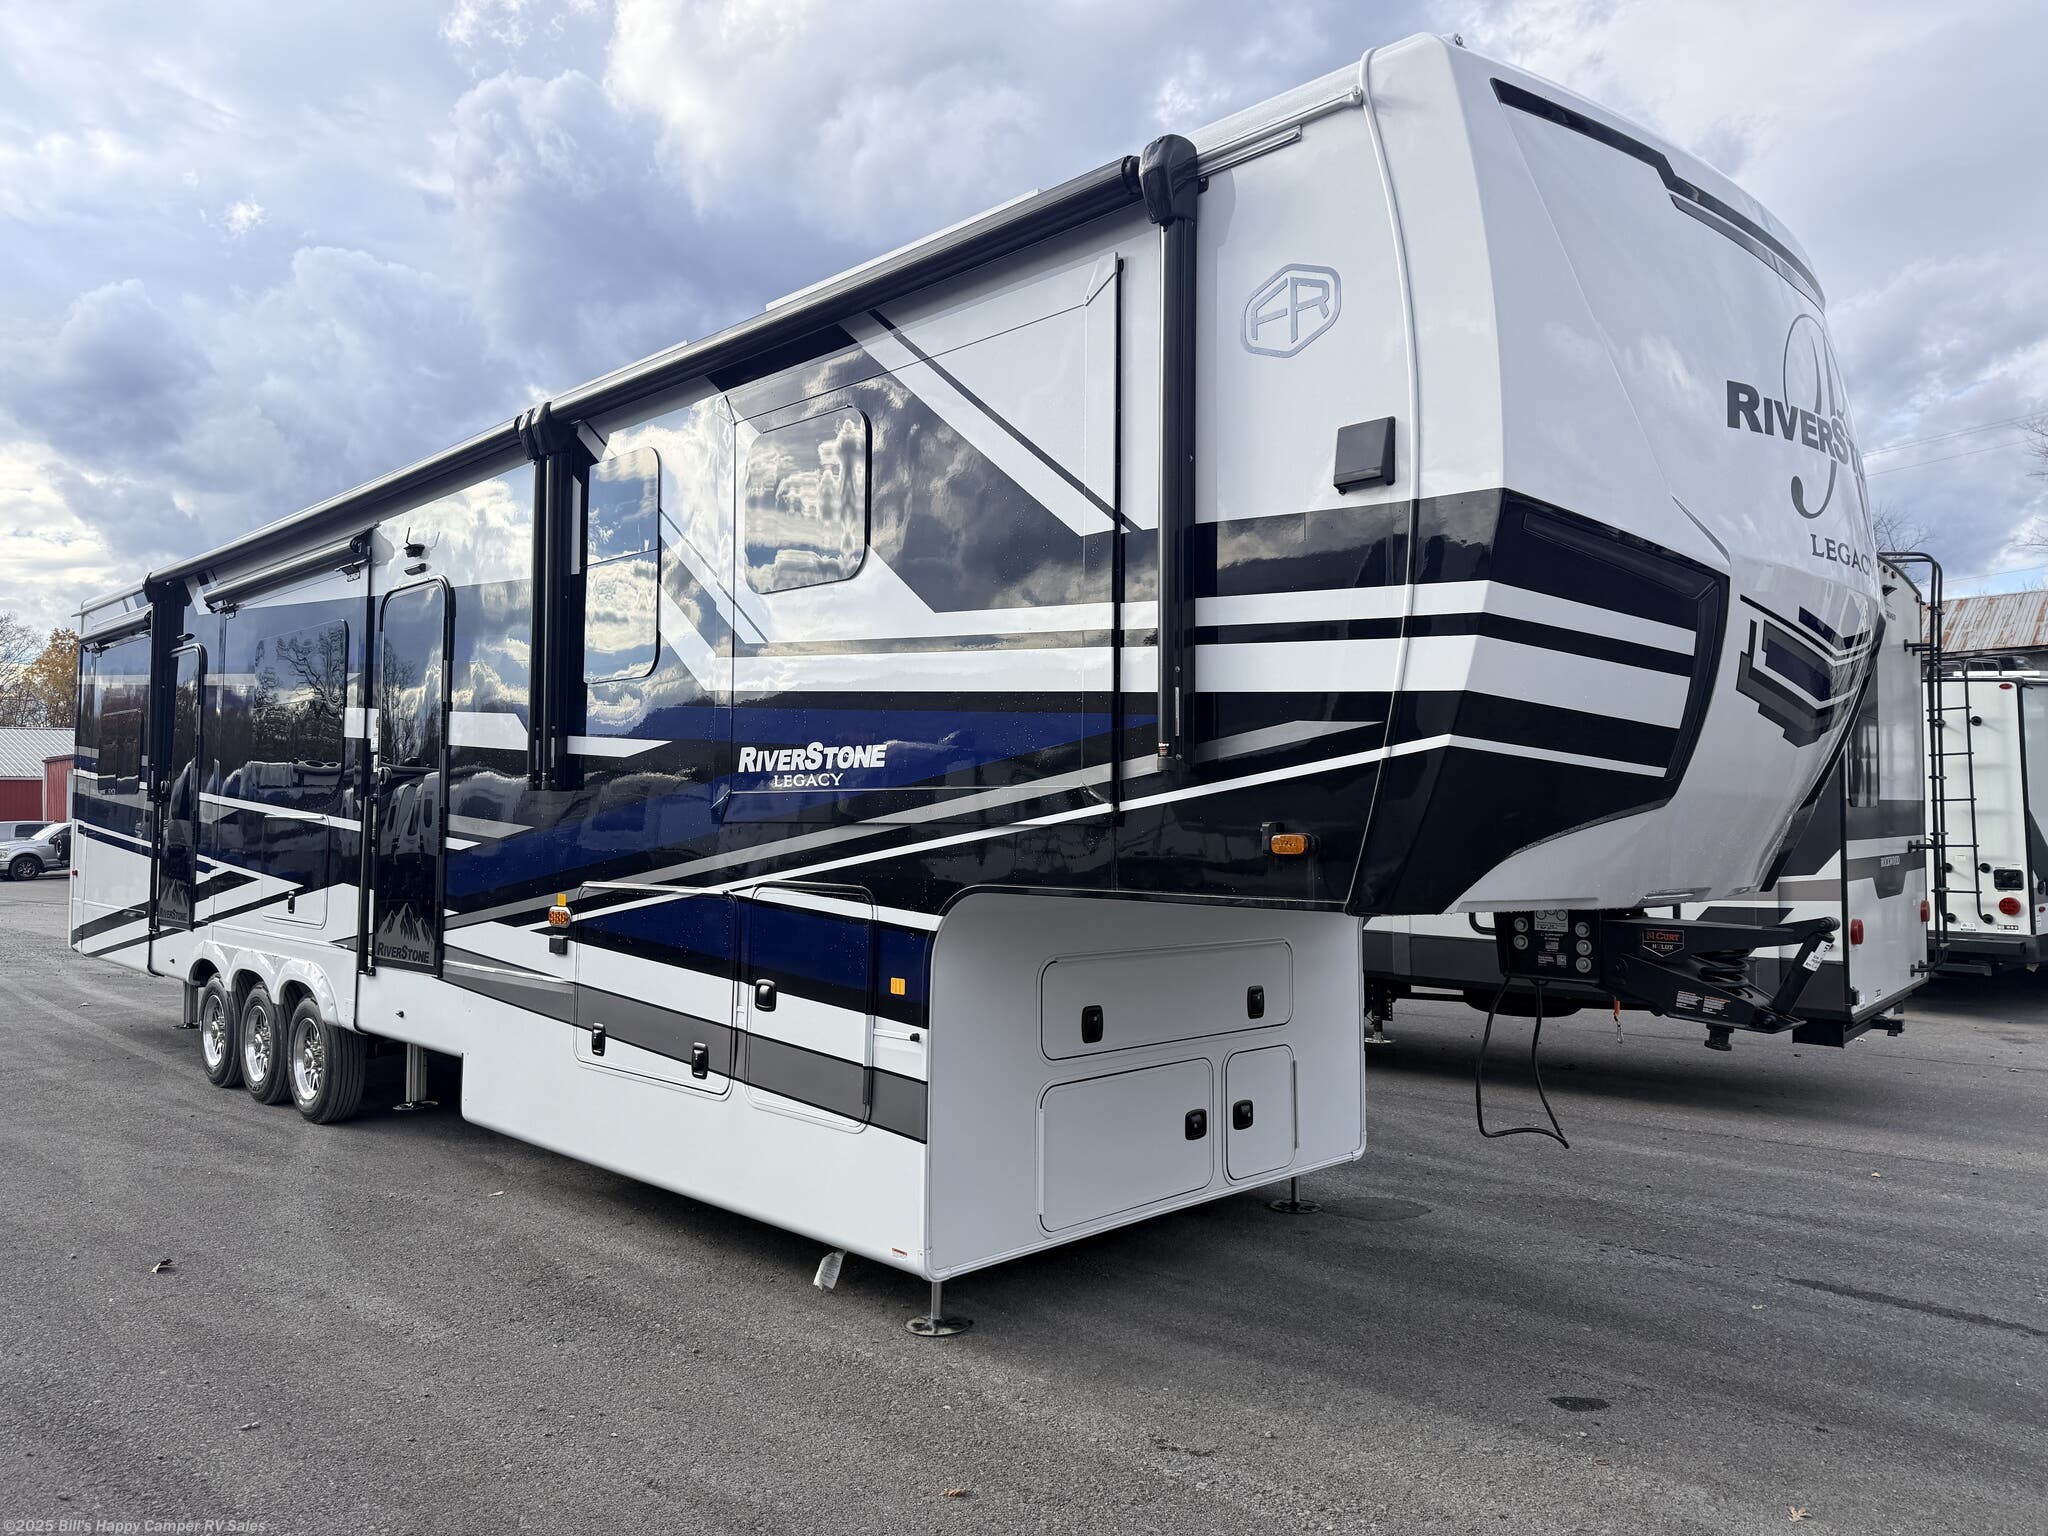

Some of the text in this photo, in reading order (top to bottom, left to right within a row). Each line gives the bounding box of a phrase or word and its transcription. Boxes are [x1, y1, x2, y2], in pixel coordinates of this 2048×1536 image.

[738, 741, 888, 773] RIVERSTONE
[774, 772, 844, 788] LEGACY
[377, 941, 430, 963] RIVERSTONE
